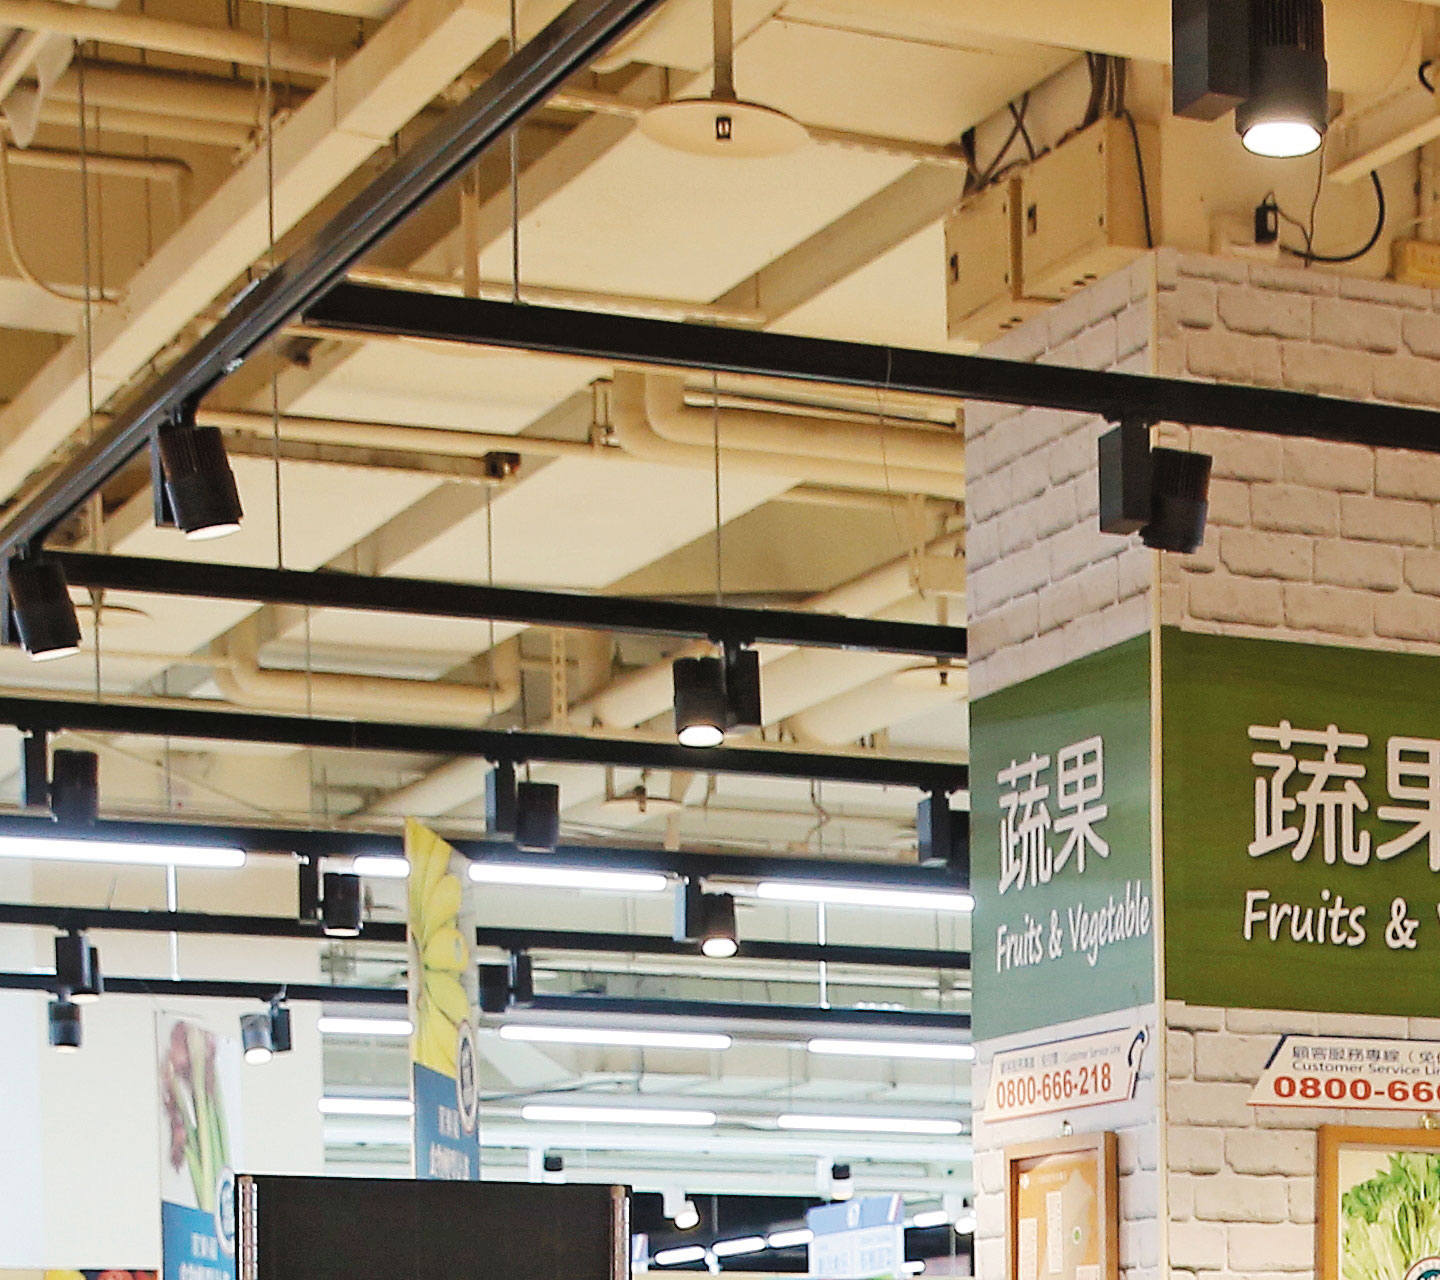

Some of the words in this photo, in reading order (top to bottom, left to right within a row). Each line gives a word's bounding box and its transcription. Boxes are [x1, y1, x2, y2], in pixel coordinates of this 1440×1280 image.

[997, 735, 1110, 895] 蔬果
[997, 913, 1042, 973] Fruits
[1048, 908, 1063, 960] &
[1068, 879, 1151, 967] Vegetable
[1243, 889, 1365, 947] Fruits
[1385, 899, 1418, 950] &
[997, 1063, 1111, 1108] 0800-666-218
[1292, 1061, 1364, 1074] Customer
[1369, 1063, 1422, 1076] Service
